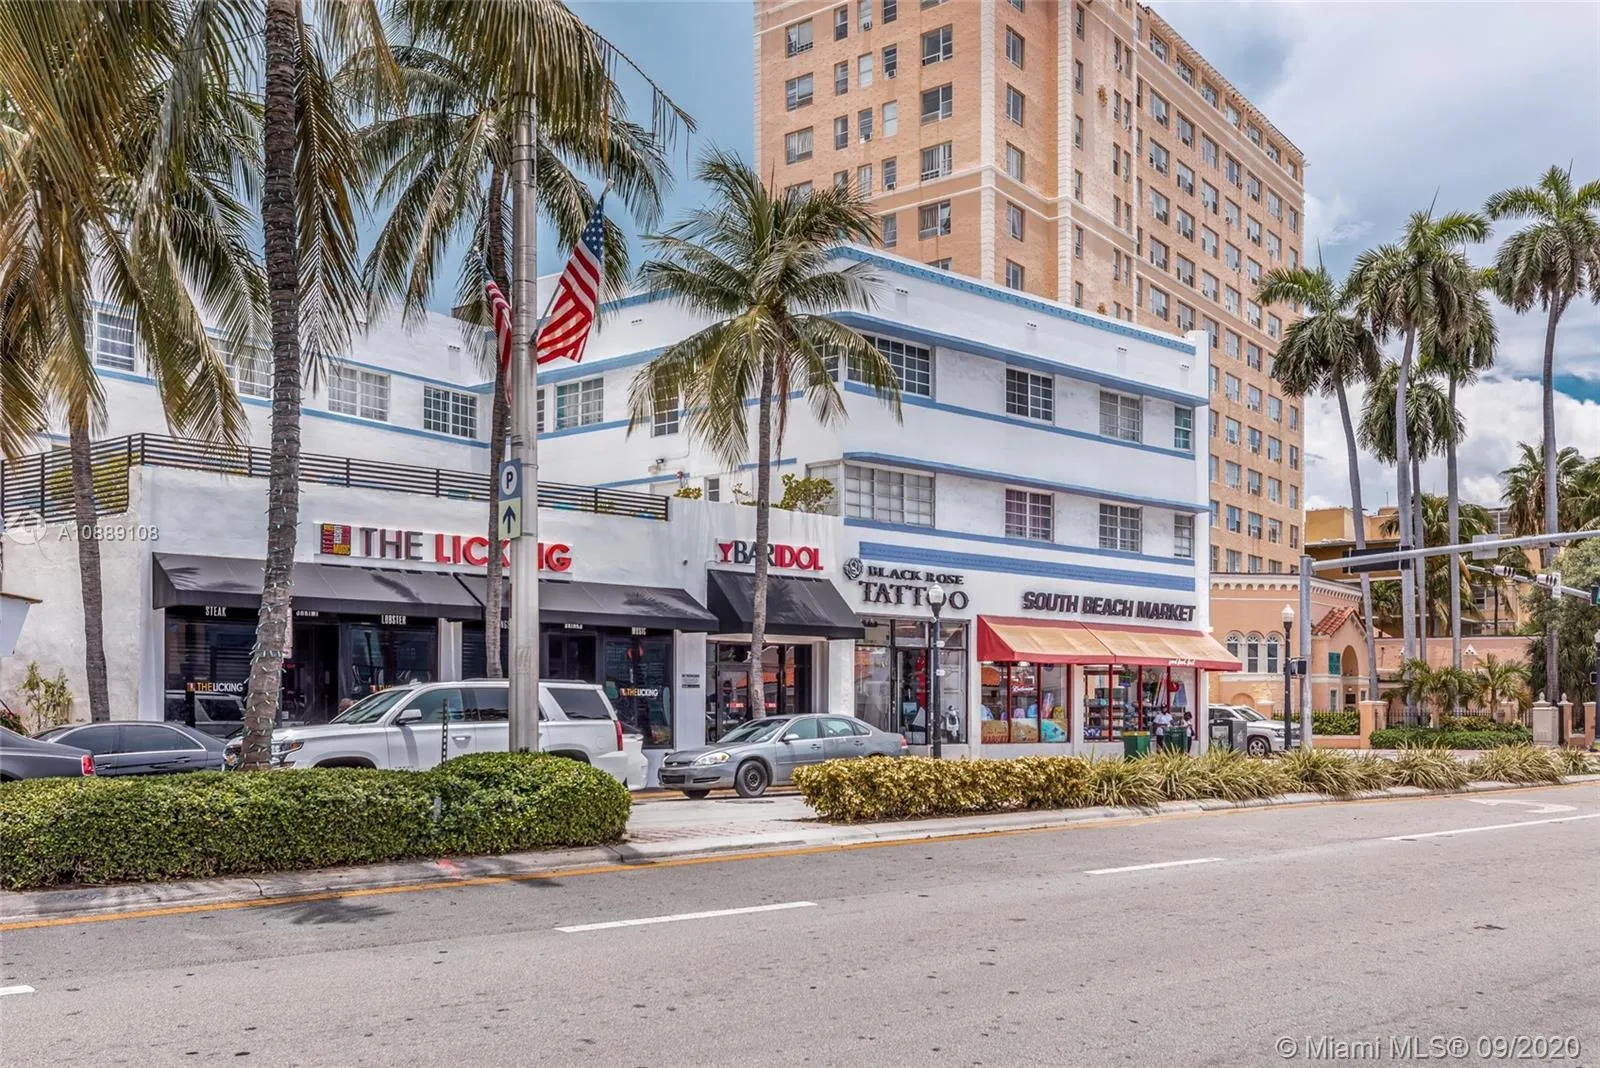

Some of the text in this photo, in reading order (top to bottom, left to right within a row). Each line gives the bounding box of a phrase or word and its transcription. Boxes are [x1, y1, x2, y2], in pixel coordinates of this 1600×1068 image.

[506, 471, 514, 490] P
[360, 527, 423, 560] THE
[435, 534, 572, 572] LICKG
[868, 566, 964, 585] BLACK ROSE
[205, 606, 226, 617] STEAK
[1022, 591, 1196, 622] SOUTH BEACH MARKET
[381, 614, 407, 625] LOBSTER
[631, 626, 647, 636] MUSIC
